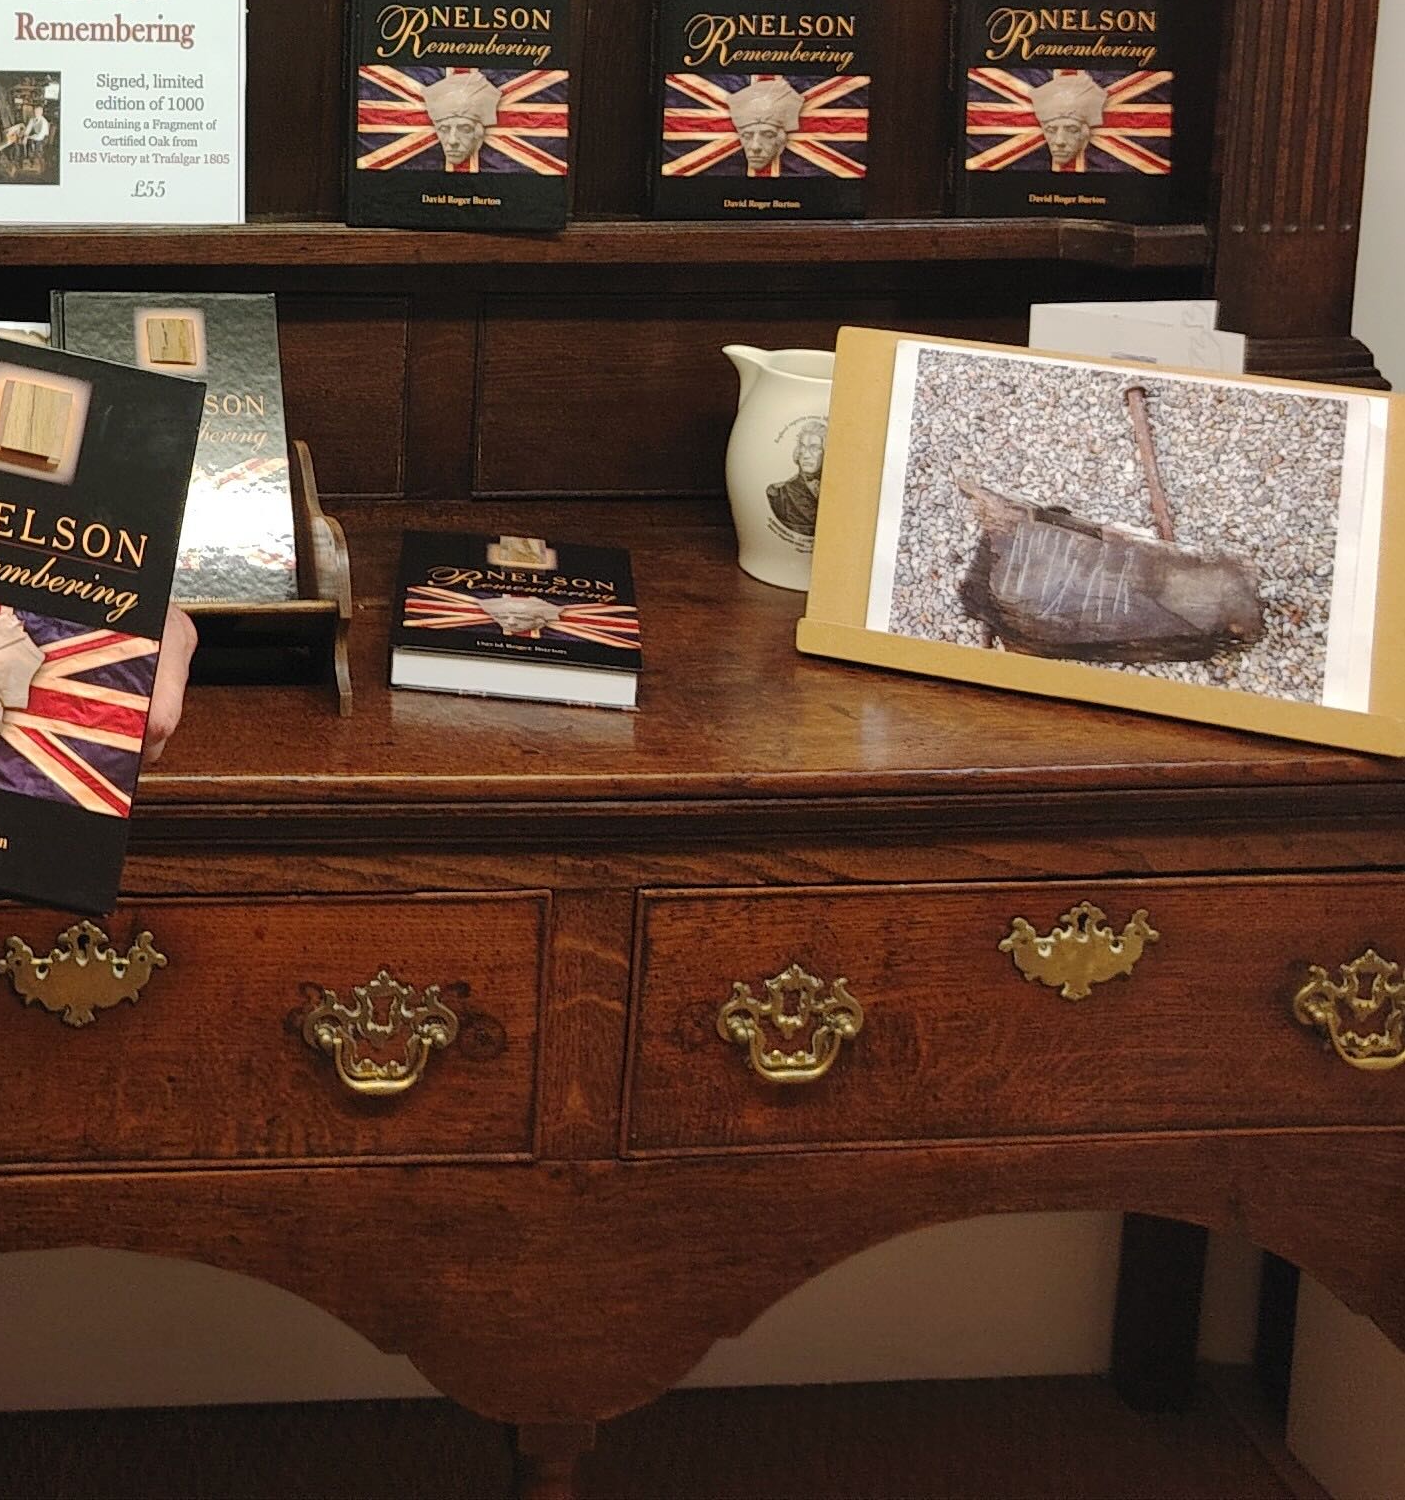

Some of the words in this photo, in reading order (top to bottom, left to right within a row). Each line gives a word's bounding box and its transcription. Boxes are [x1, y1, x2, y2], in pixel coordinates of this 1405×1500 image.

[431, 6, 551, 30] NELSON
[738, 15, 855, 37] NELSON
[1039, 9, 1156, 32] NELSON
[15, 12, 195, 49] Remembering
[377, 5, 552, 66] Remembering
[986, 8, 1157, 66] Remembering
[684, 14, 855, 72] Remembering
[96, 74, 150, 91] Signed,
[153, 74, 204, 89] limited
[95, 96, 146, 111] edition
[149, 96, 166, 111] of
[168, 97, 205, 111] 1000
[83, 118, 141, 132] Containing
[143, 121, 150, 130] a
[152, 118, 203, 132] Fragment
[206, 118, 217, 130] of
[101, 136, 146, 147] Certified
[148, 136, 169, 147] Oak
[172, 136, 198, 147] from
[69, 152, 97, 164] HMS
[99, 152, 137, 166] Victory
[139, 154, 150, 164] at
[151, 152, 201, 166] Trafalgar
[204, 153, 230, 165] 1805
[131, 180, 166, 198] £55
[204, 394, 264, 417] SON
[197, 420, 267, 453] bering
[427, 566, 616, 603] Remembering
[486, 570, 614, 592] NELSON
